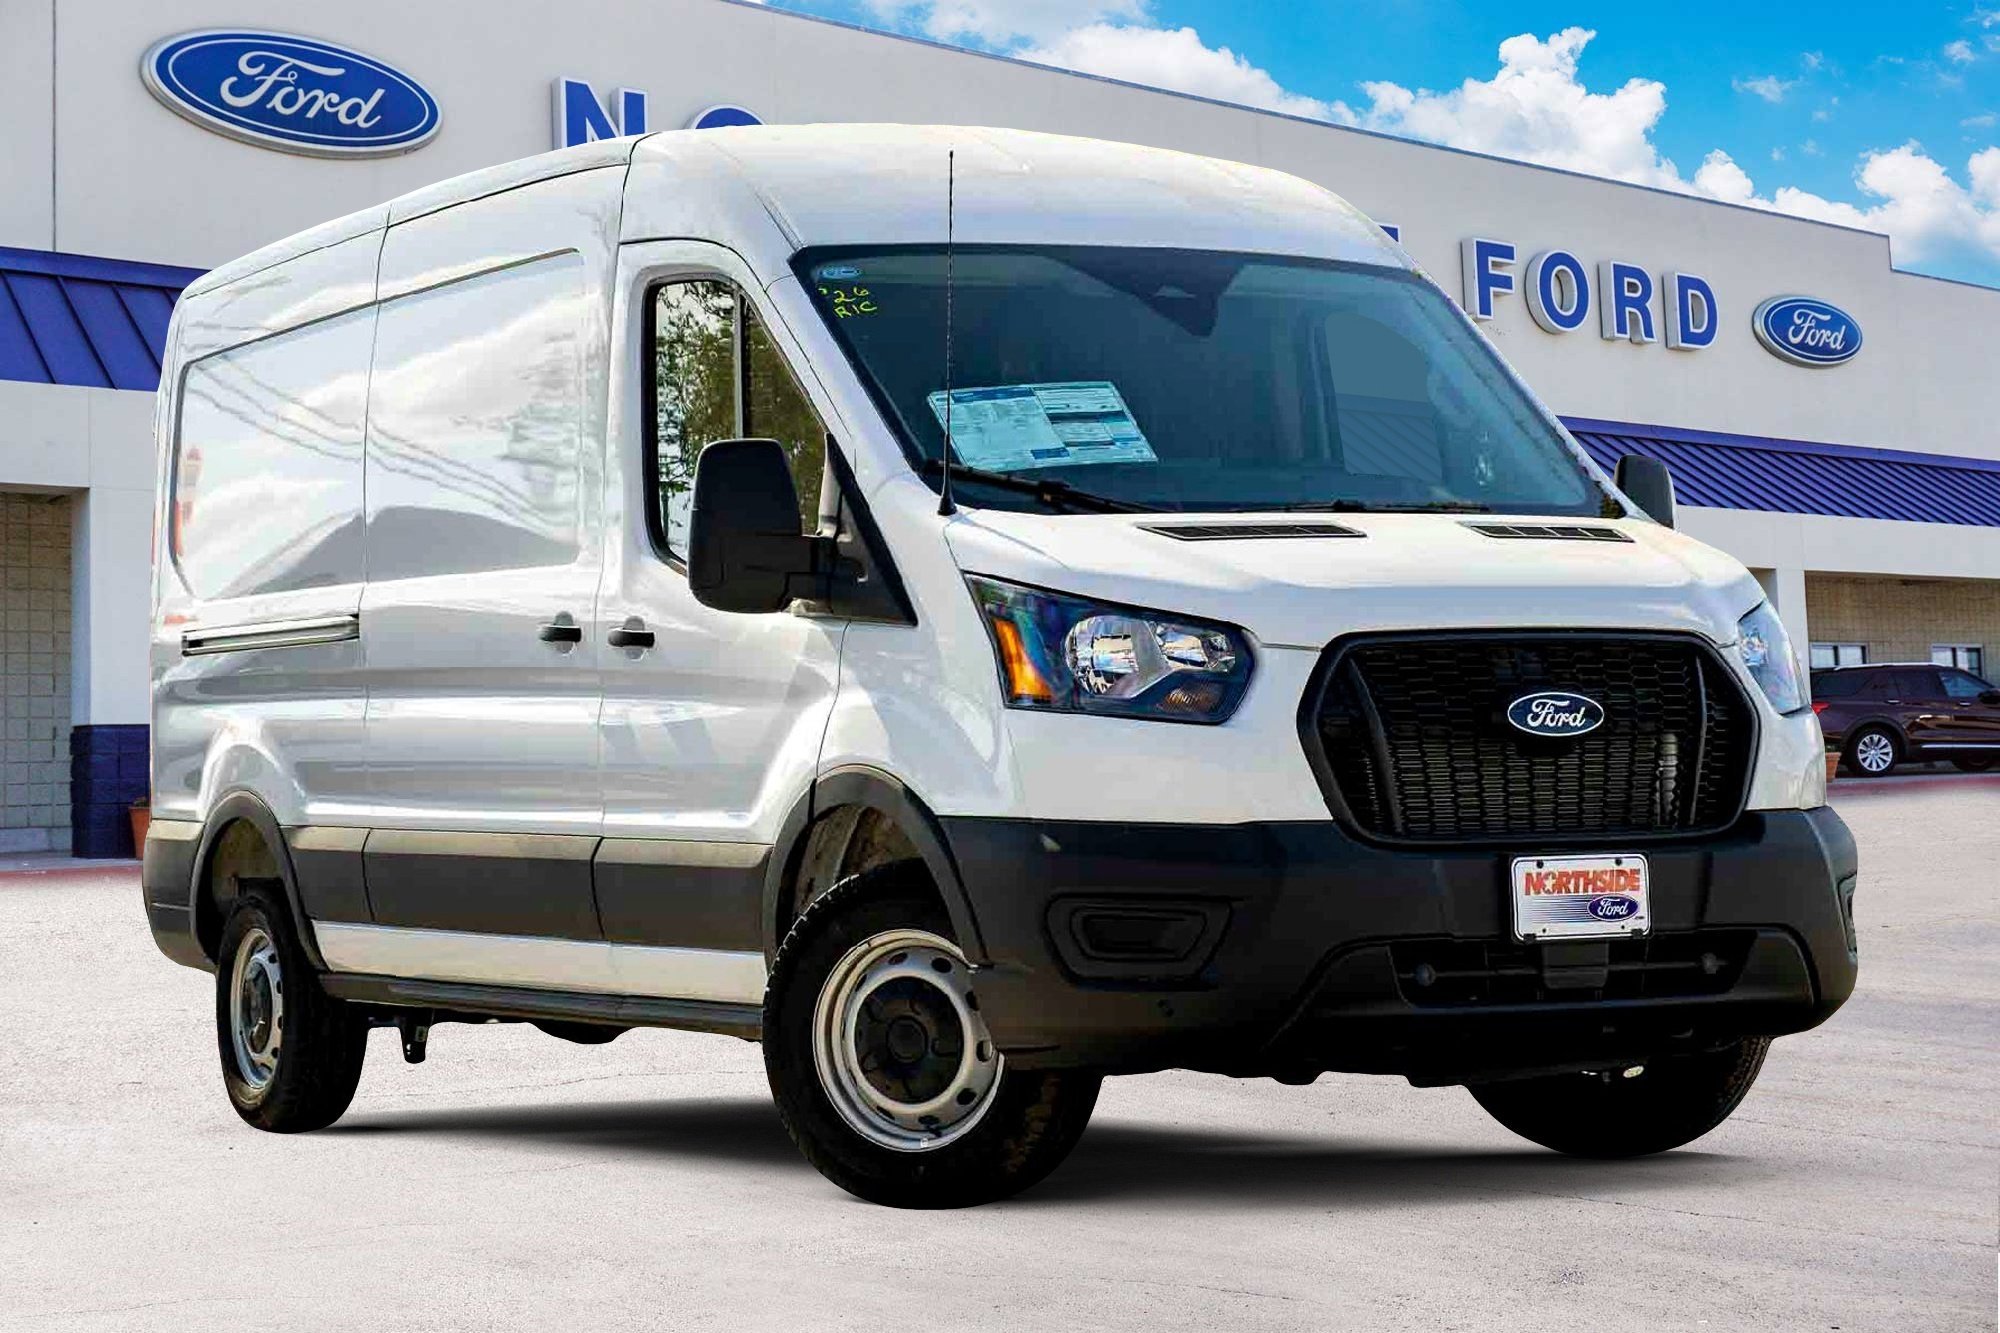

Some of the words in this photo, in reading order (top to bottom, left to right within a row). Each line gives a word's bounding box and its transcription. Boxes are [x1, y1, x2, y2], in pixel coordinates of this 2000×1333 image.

[219, 50, 386, 129] Ford
[1463, 236, 1720, 351] FORD
[1788, 309, 1847, 351] Ford
[1526, 699, 1586, 728] Ford
[1524, 867, 1641, 896] NORTHSIDE
[1597, 897, 1630, 917] Ford
